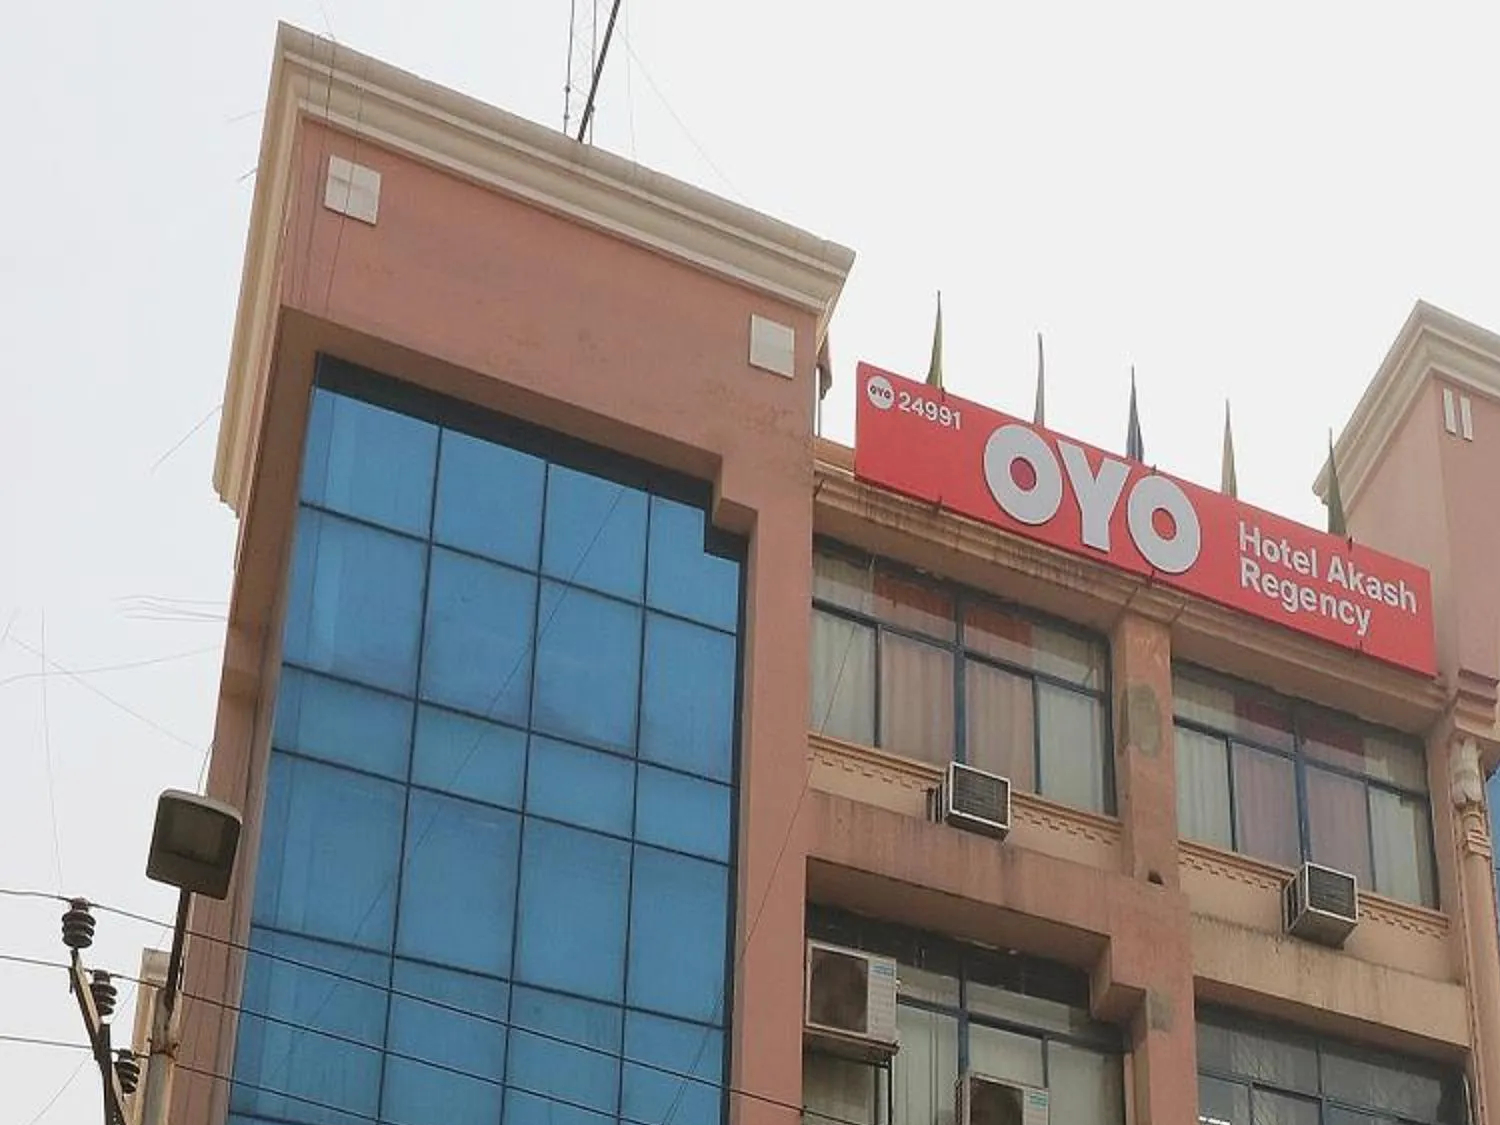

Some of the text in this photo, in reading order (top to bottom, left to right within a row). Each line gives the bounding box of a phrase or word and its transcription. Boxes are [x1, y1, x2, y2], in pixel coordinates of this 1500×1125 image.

[870, 385, 961, 430] OYO 24991
[983, 424, 1201, 574] OYO
[1238, 522, 1417, 613] Hotel Akash
[1240, 556, 1372, 637] Regency
